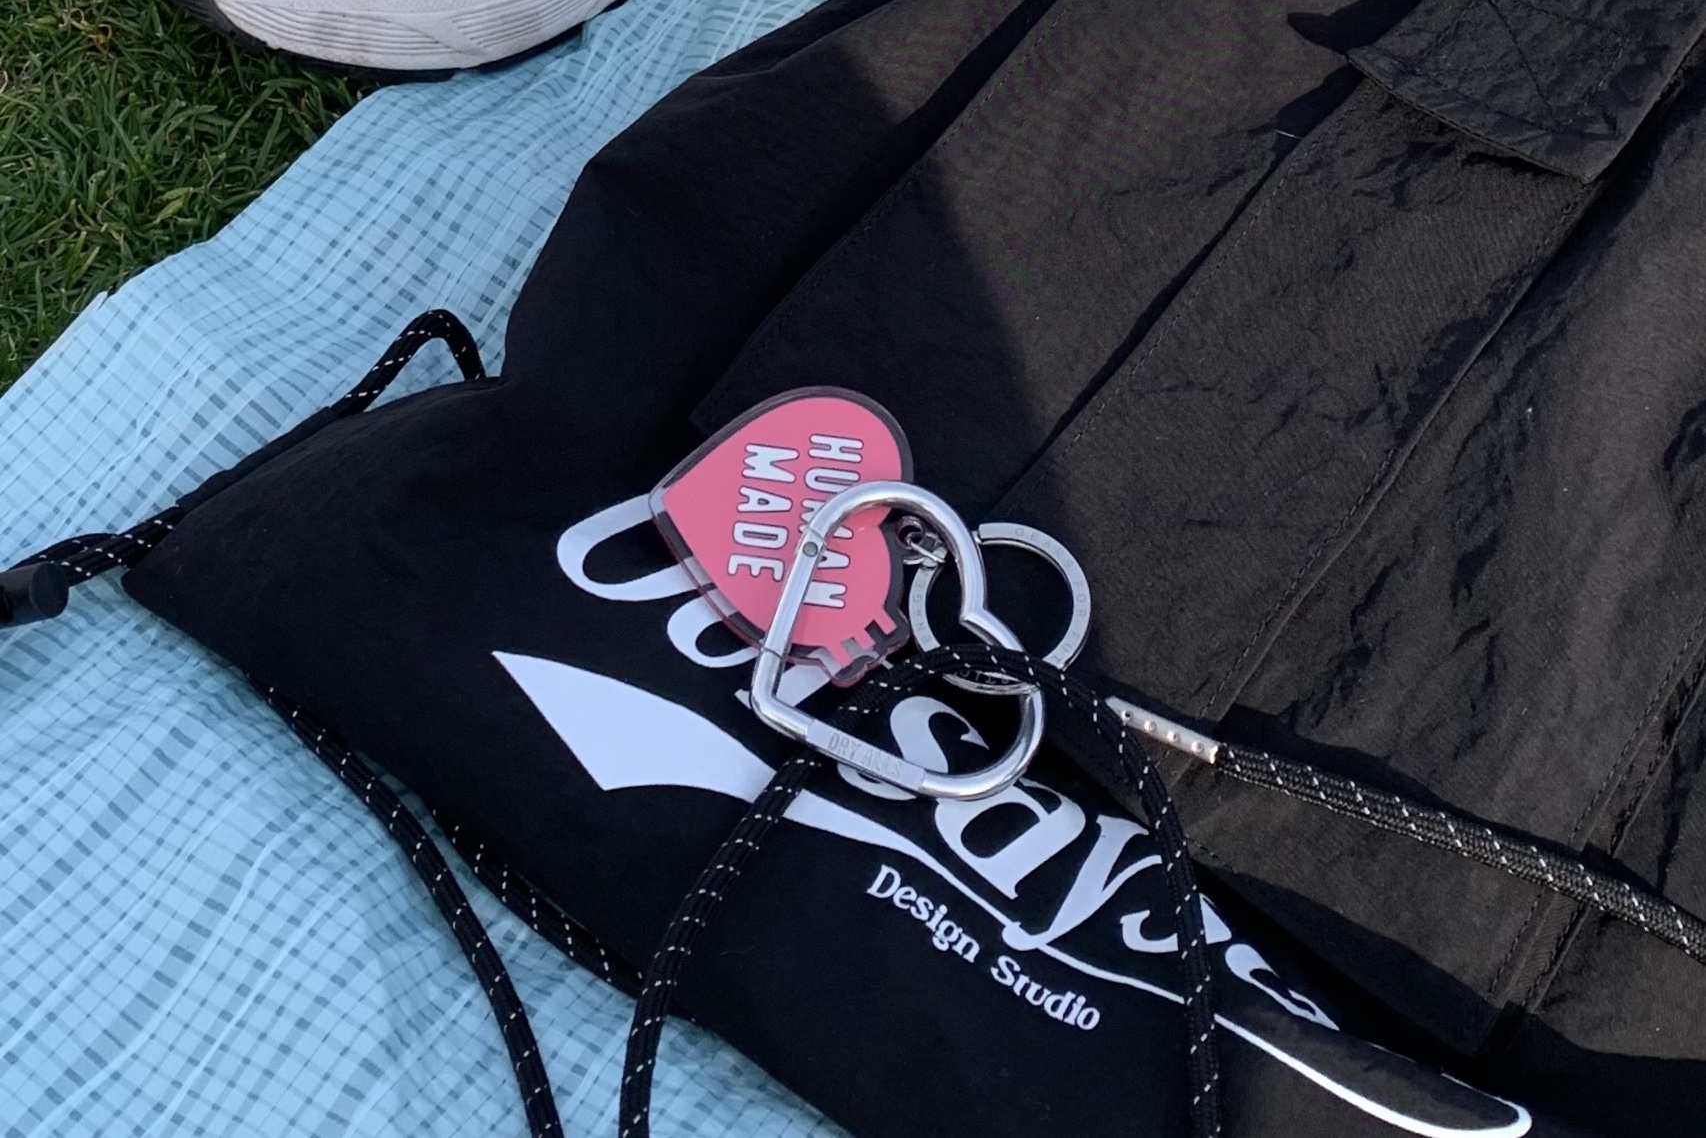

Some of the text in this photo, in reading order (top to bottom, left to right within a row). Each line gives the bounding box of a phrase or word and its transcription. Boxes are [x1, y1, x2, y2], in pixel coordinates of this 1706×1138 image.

[728, 443, 800, 582] MADE
[1073, 579, 1087, 619] FOR
[828, 732, 861, 761] DRY
[866, 863, 1101, 1031] Design Studio
